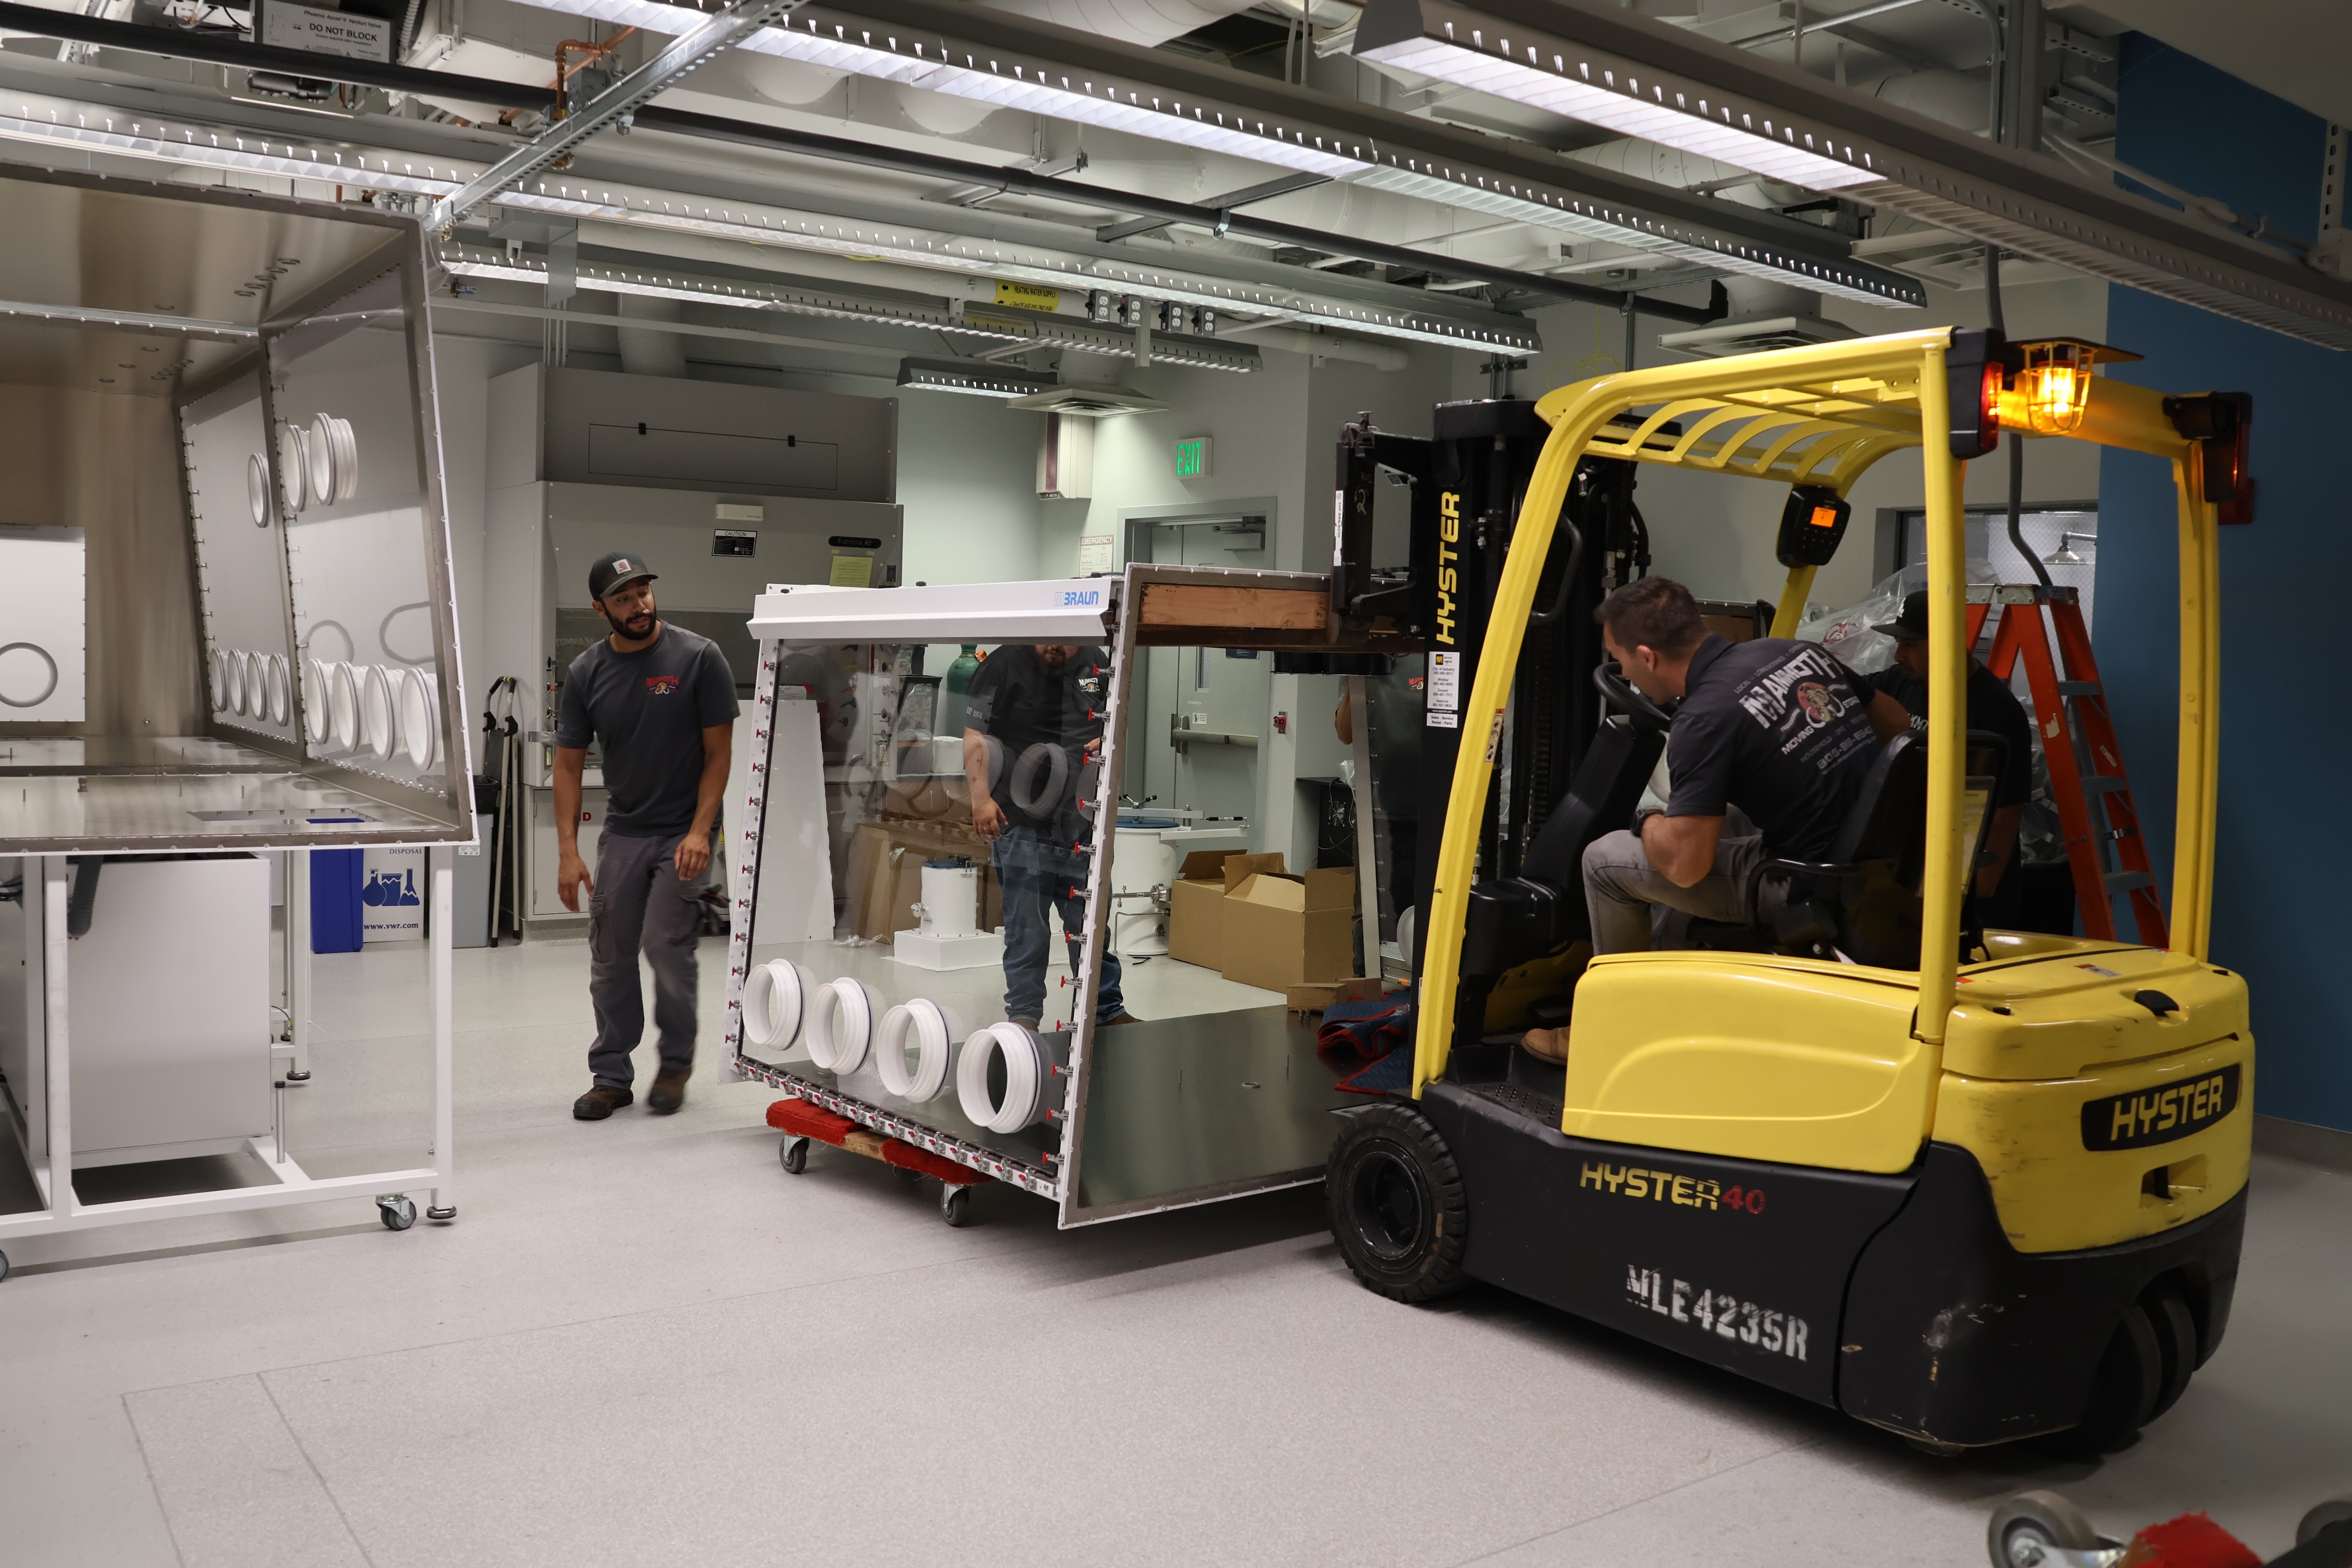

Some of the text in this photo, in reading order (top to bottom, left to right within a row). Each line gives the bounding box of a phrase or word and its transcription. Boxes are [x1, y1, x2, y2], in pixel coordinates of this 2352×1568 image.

[304, 10, 325, 19] Phoenix
[309, 23, 377, 42] DO NOT BLOCK
[1014, 286, 1030, 294] HEATING
[1030, 288, 1042, 296] WATER
[1177, 442, 1202, 475] EXIT
[1081, 536, 1113, 545] EMERGENCY
[1436, 491, 1460, 645] HYSTER
[1078, 677, 1098, 686] MAMMOT
[1734, 680, 1751, 694] LOCAL
[1738, 649, 1844, 729] MAMMOTH
[1781, 725, 1814, 755] MOVING
[1800, 736, 1832, 763] HOUSEHOLD
[2111, 1075, 2223, 1142] HYSTER
[1579, 1161, 1765, 1214] HYSTER 40
